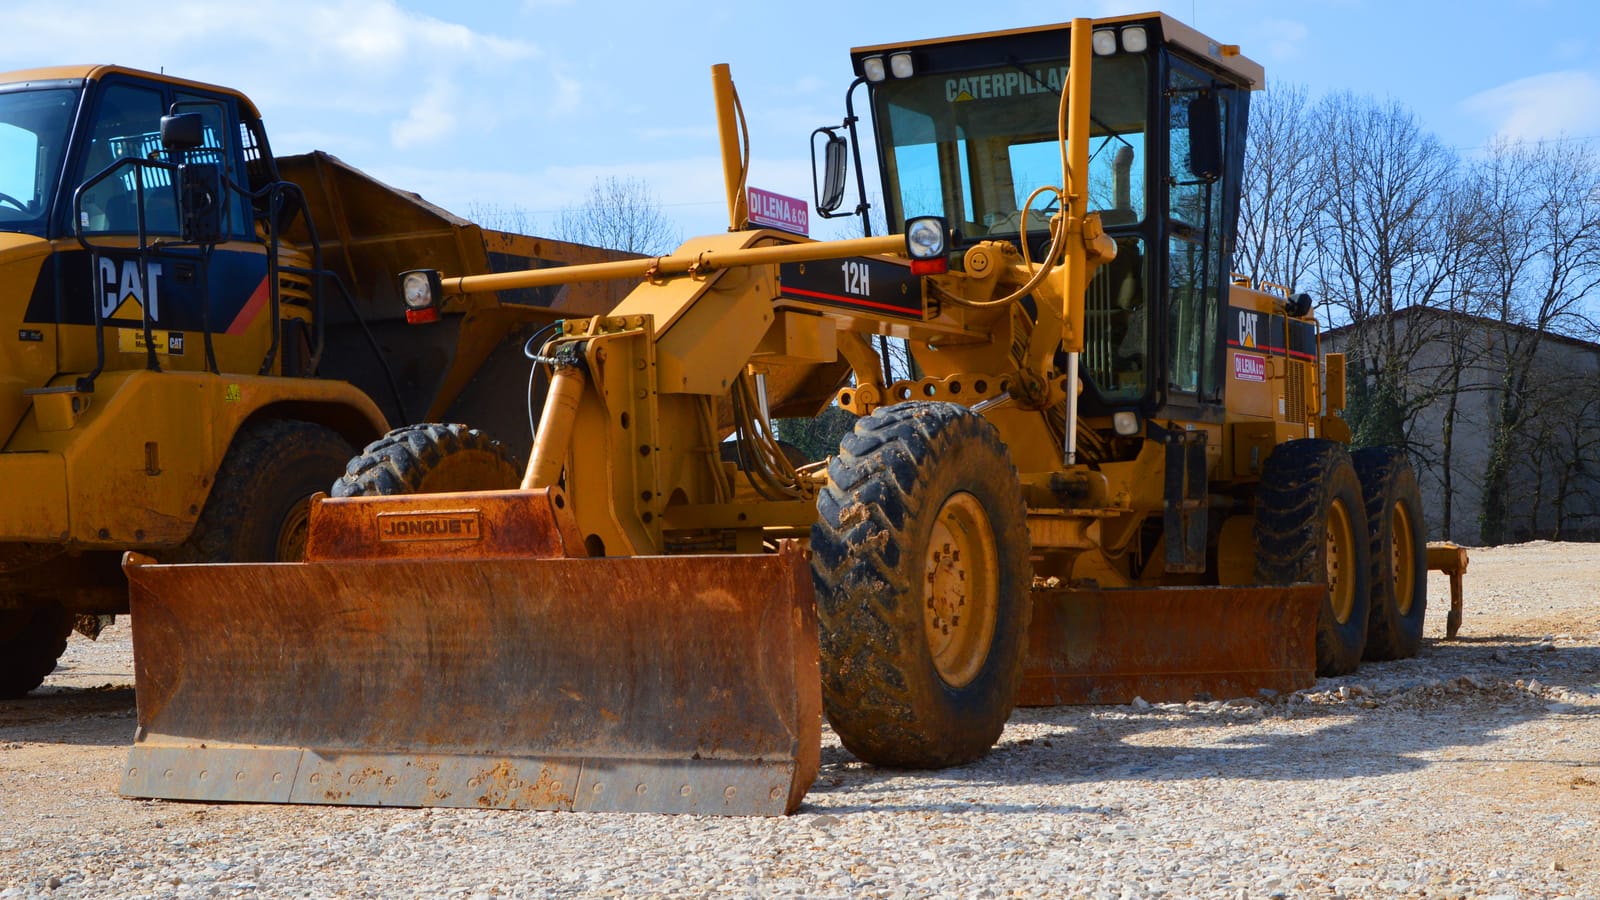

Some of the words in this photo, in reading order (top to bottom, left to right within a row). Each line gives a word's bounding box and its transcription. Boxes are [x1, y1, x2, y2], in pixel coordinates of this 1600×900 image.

[750, 191, 761, 215] DI
[763, 195, 791, 222] LENA
[792, 207, 797, 223] &
[798, 208, 807, 225] CO
[99, 256, 163, 322] CAT
[841, 261, 870, 296] 12H
[169, 337, 183, 350] CAT
[1238, 310, 1258, 348] CAT
[384, 518, 475, 536] JONQUET
